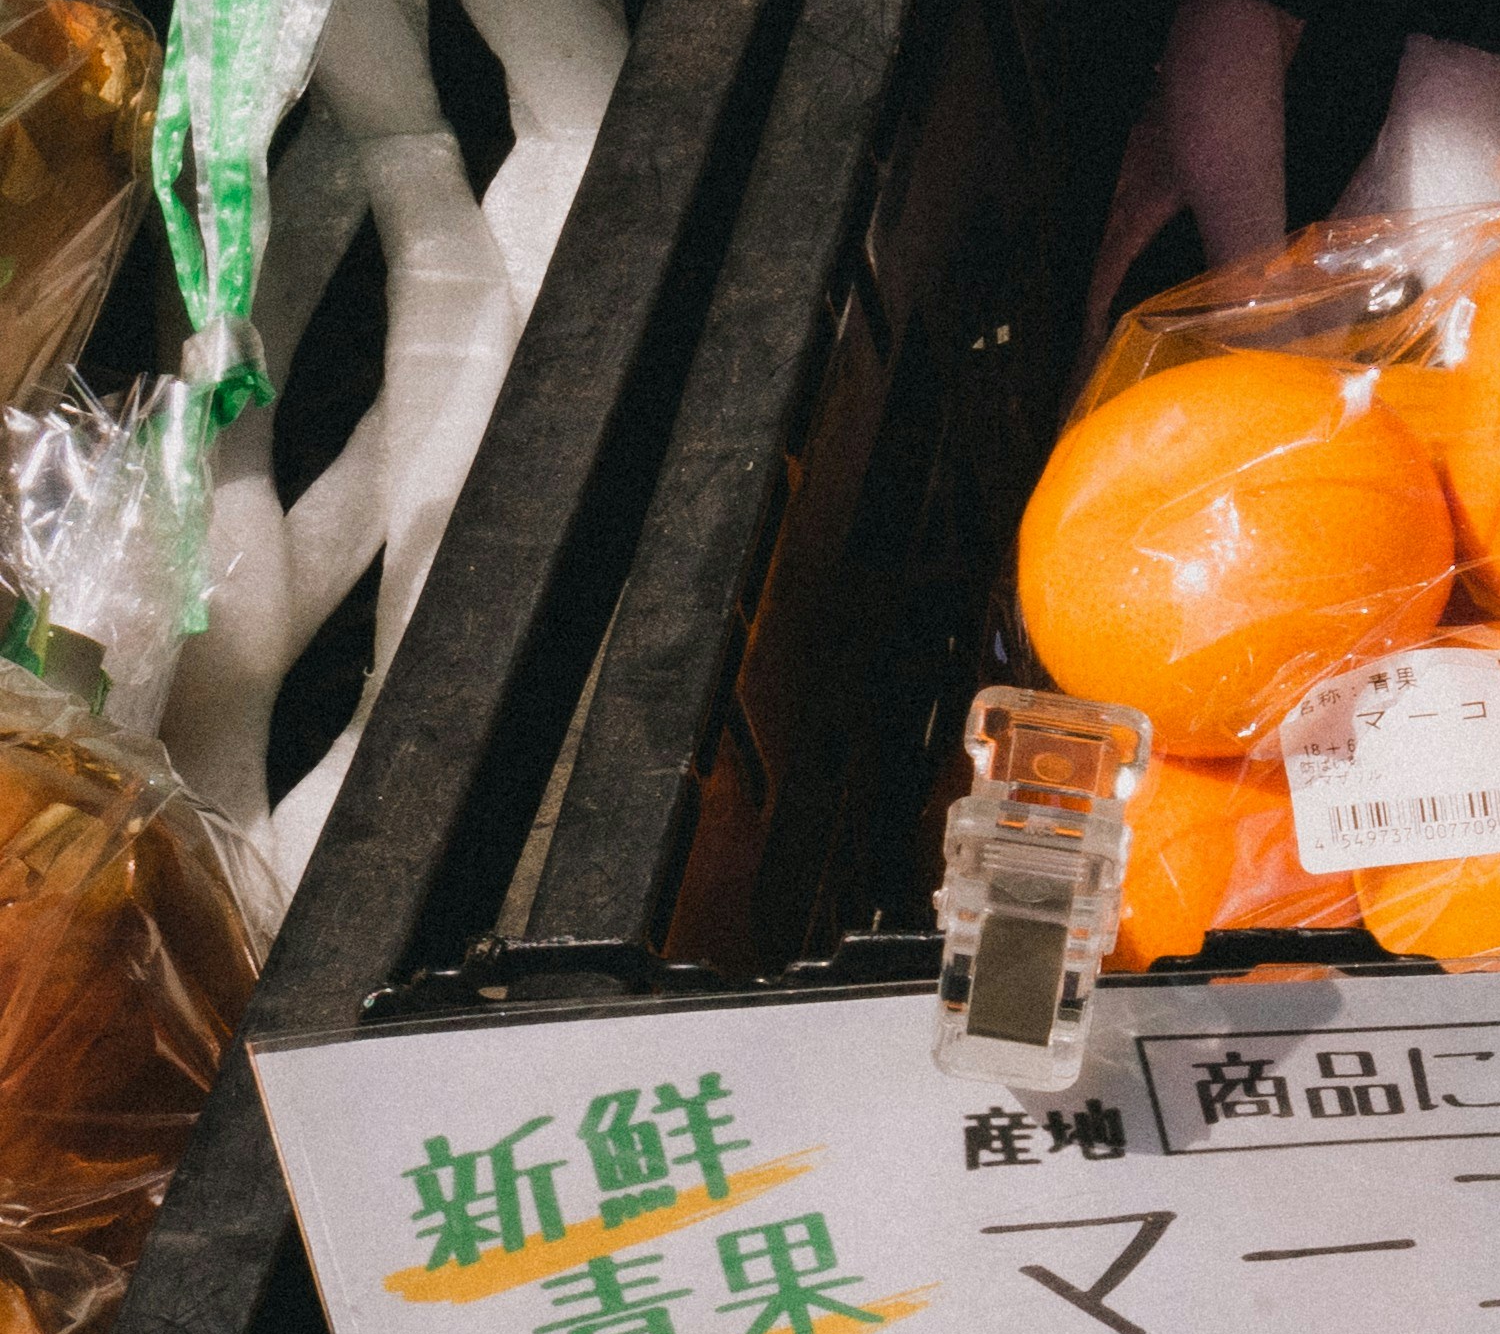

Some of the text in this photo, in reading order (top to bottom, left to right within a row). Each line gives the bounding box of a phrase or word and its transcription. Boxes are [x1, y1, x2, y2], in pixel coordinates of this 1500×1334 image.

[1341, 826, 1413, 849] 549737
[1424, 818, 1498, 840] 007709
[964, 1097, 1127, 1170] 産地
[401, 1071, 751, 1271] 新鮮
